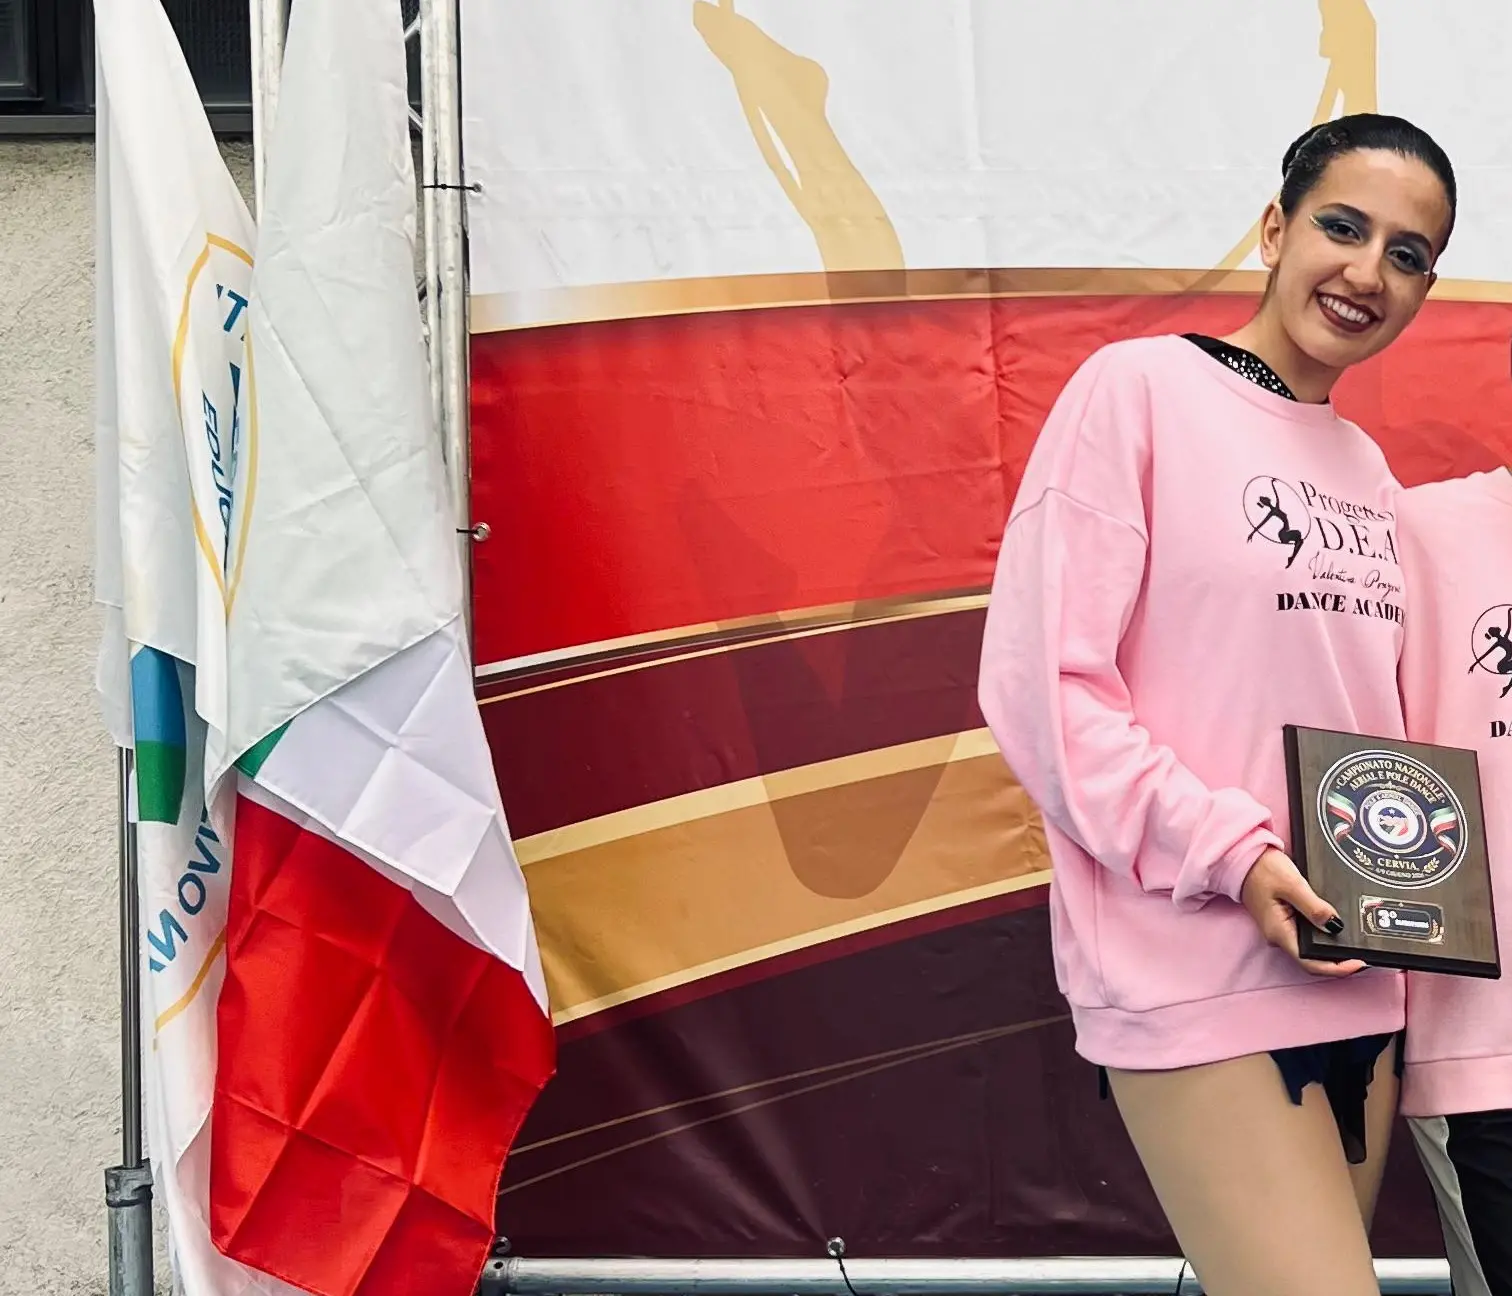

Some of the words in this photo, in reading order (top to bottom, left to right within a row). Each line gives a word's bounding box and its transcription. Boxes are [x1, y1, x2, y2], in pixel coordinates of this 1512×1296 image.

[1276, 591, 1347, 613] DANCE
[1336, 760, 1392, 787] CAMPIONATO
[1394, 762, 1444, 800] NAZIONALE
